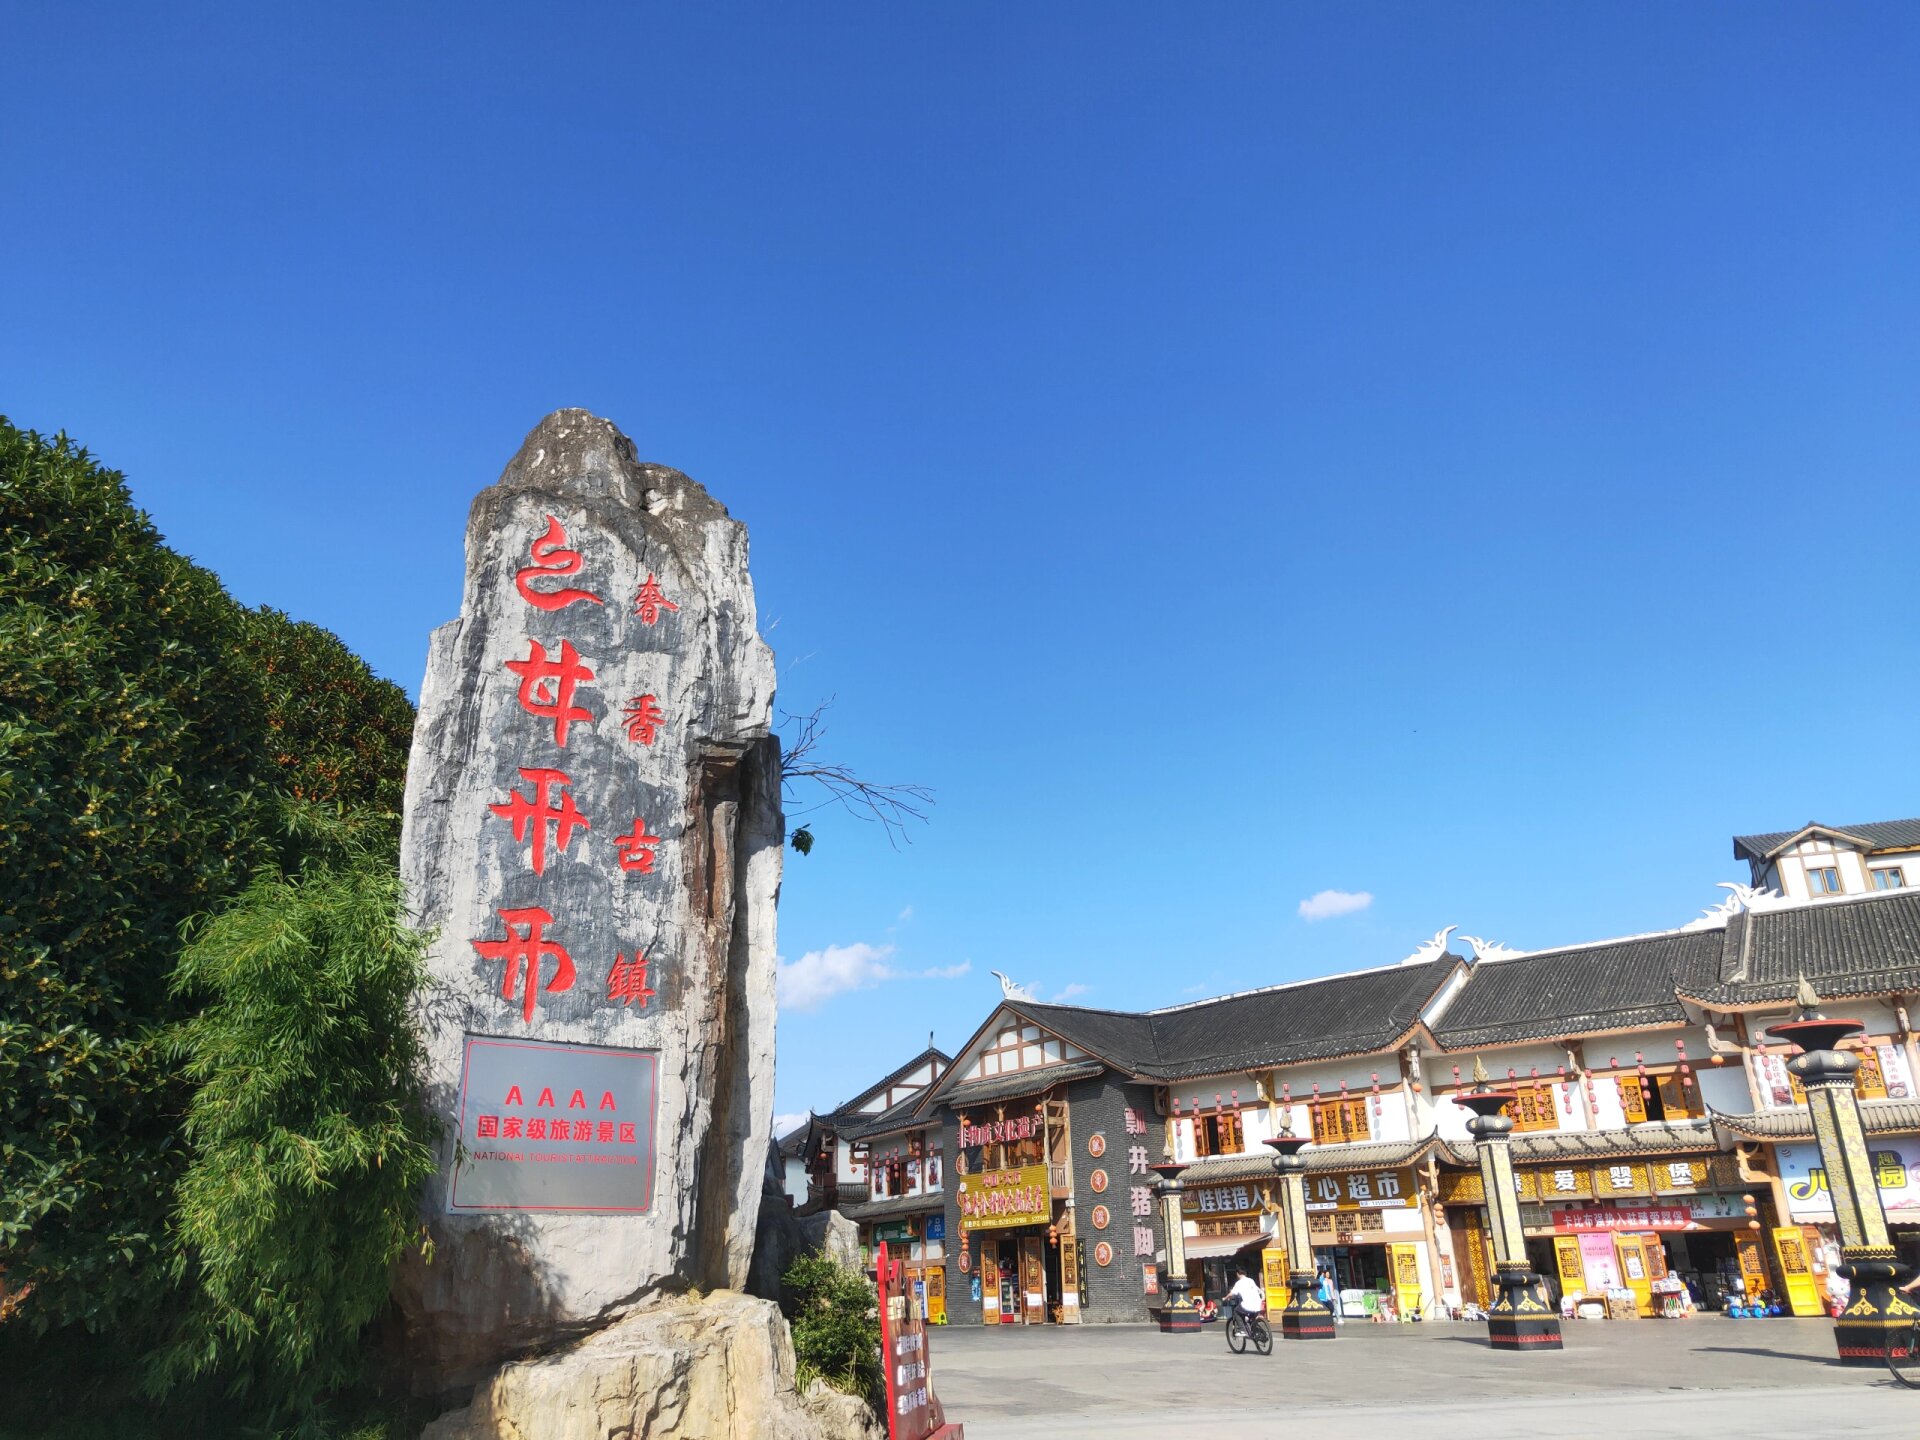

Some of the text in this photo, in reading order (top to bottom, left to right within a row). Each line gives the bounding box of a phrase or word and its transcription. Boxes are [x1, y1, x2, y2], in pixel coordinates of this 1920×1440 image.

[477, 1115, 637, 1143] 国家级旅游景区
[957, 1114, 1043, 1148] 非物质文化遗产
[473, 1151, 524, 1161] NATIONAL
[529, 1152, 573, 1163] TOURIST
[1198, 1184, 1267, 1212] 娃娃猎人
